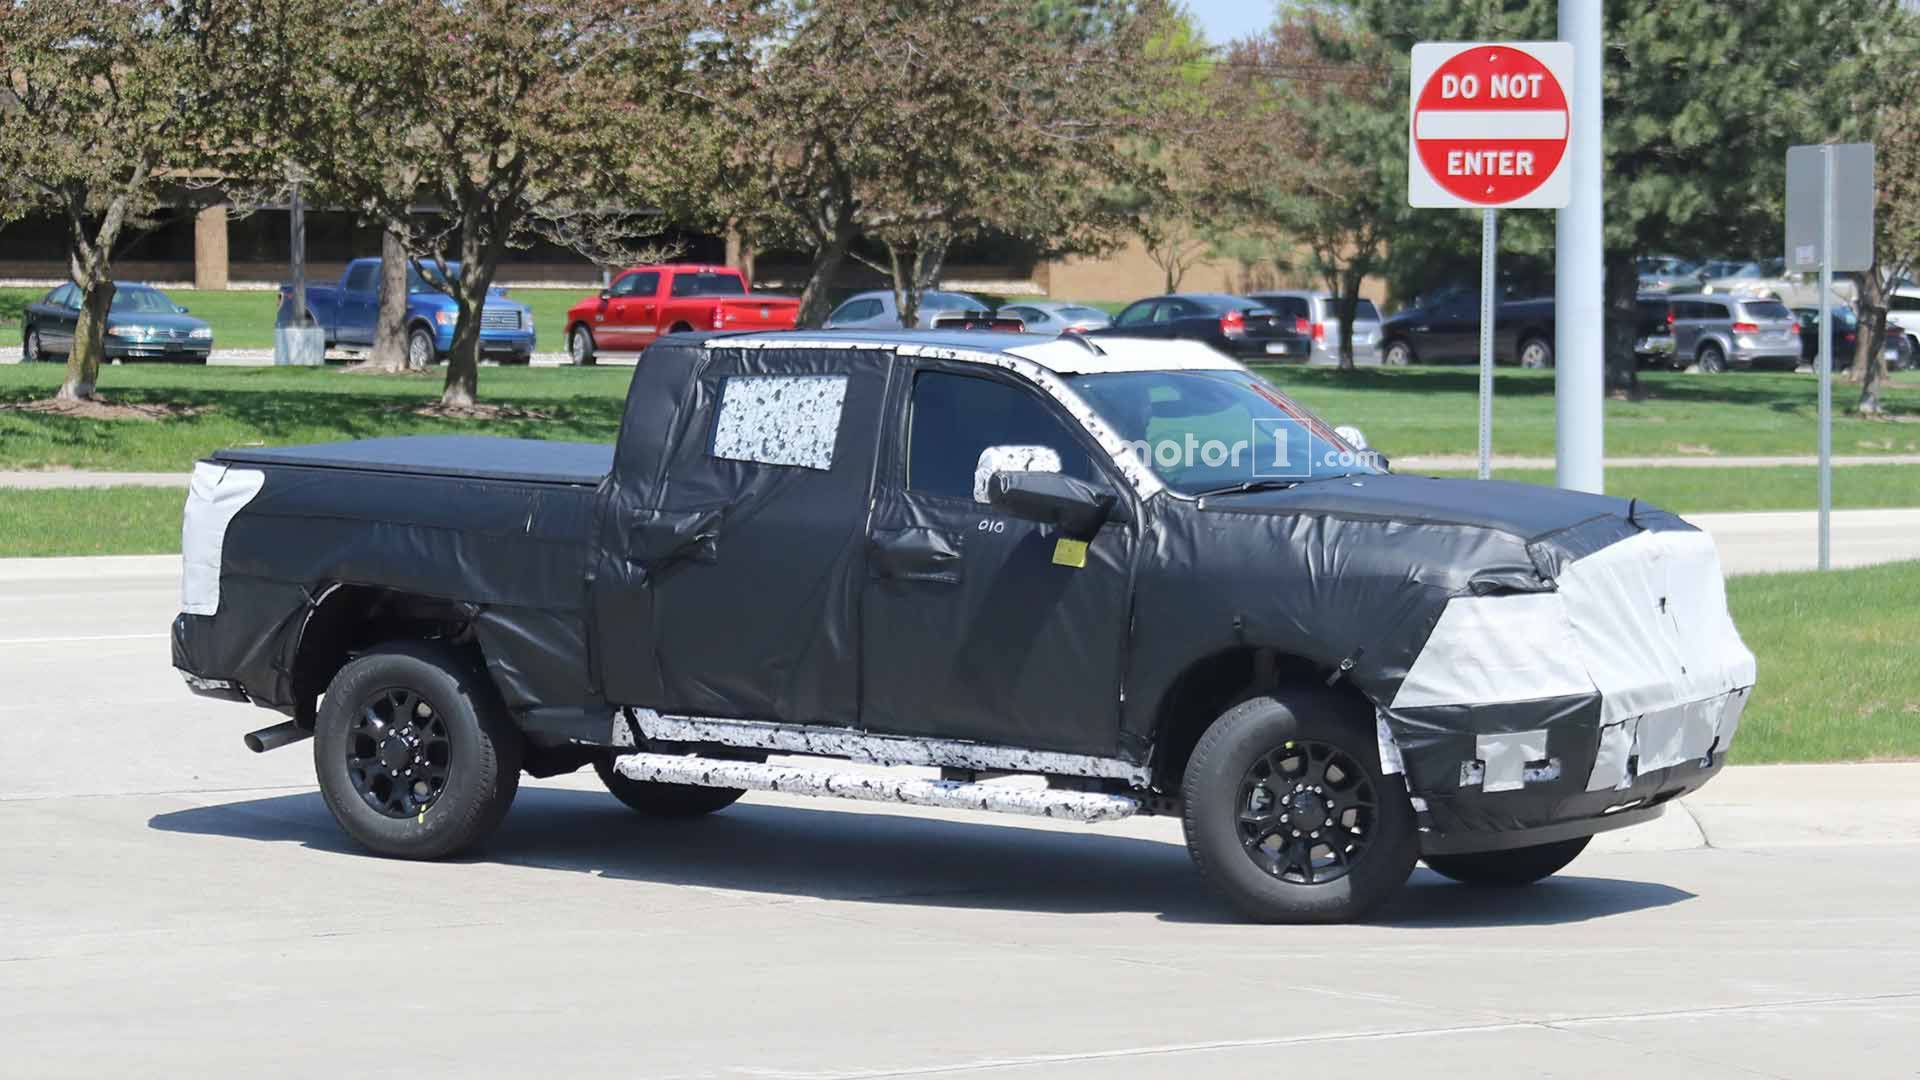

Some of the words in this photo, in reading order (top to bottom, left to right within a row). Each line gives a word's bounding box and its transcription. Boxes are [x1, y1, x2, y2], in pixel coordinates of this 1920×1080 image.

[1441, 75, 1479, 99] DO
[1490, 74, 1543, 99] NOT
[1447, 151, 1534, 176] ENTER
